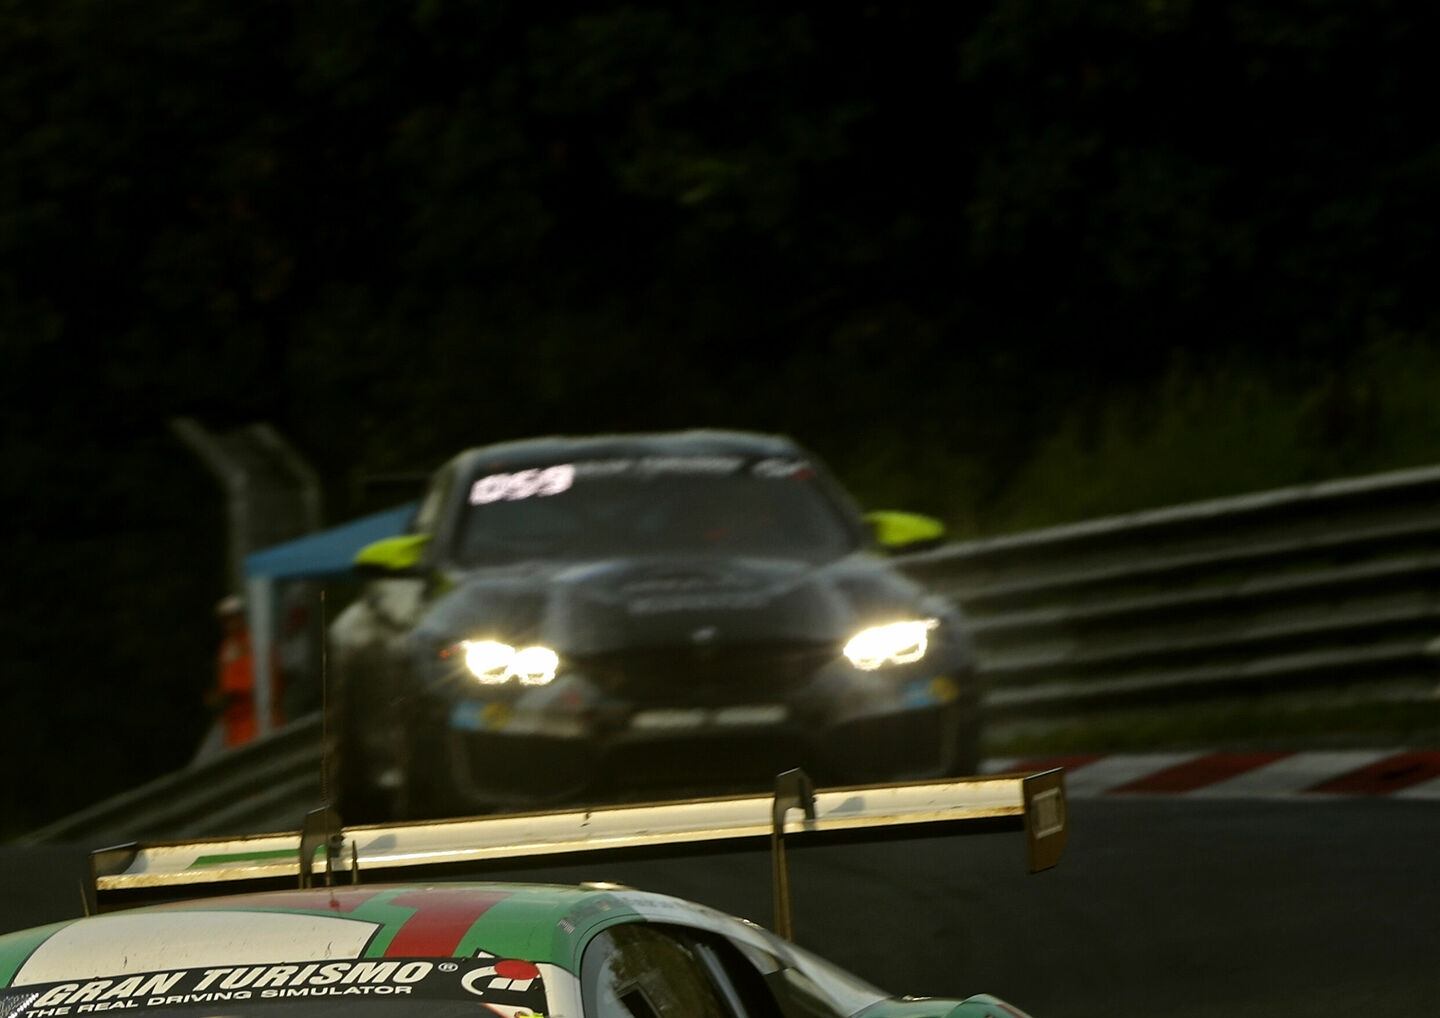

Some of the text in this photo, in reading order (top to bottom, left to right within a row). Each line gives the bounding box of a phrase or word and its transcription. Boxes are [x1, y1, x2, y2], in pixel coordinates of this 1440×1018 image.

[26, 985, 413, 1018] THE REAL DRIVING SIMULATOR
[32, 961, 434, 1008] GRAN TURISMO
